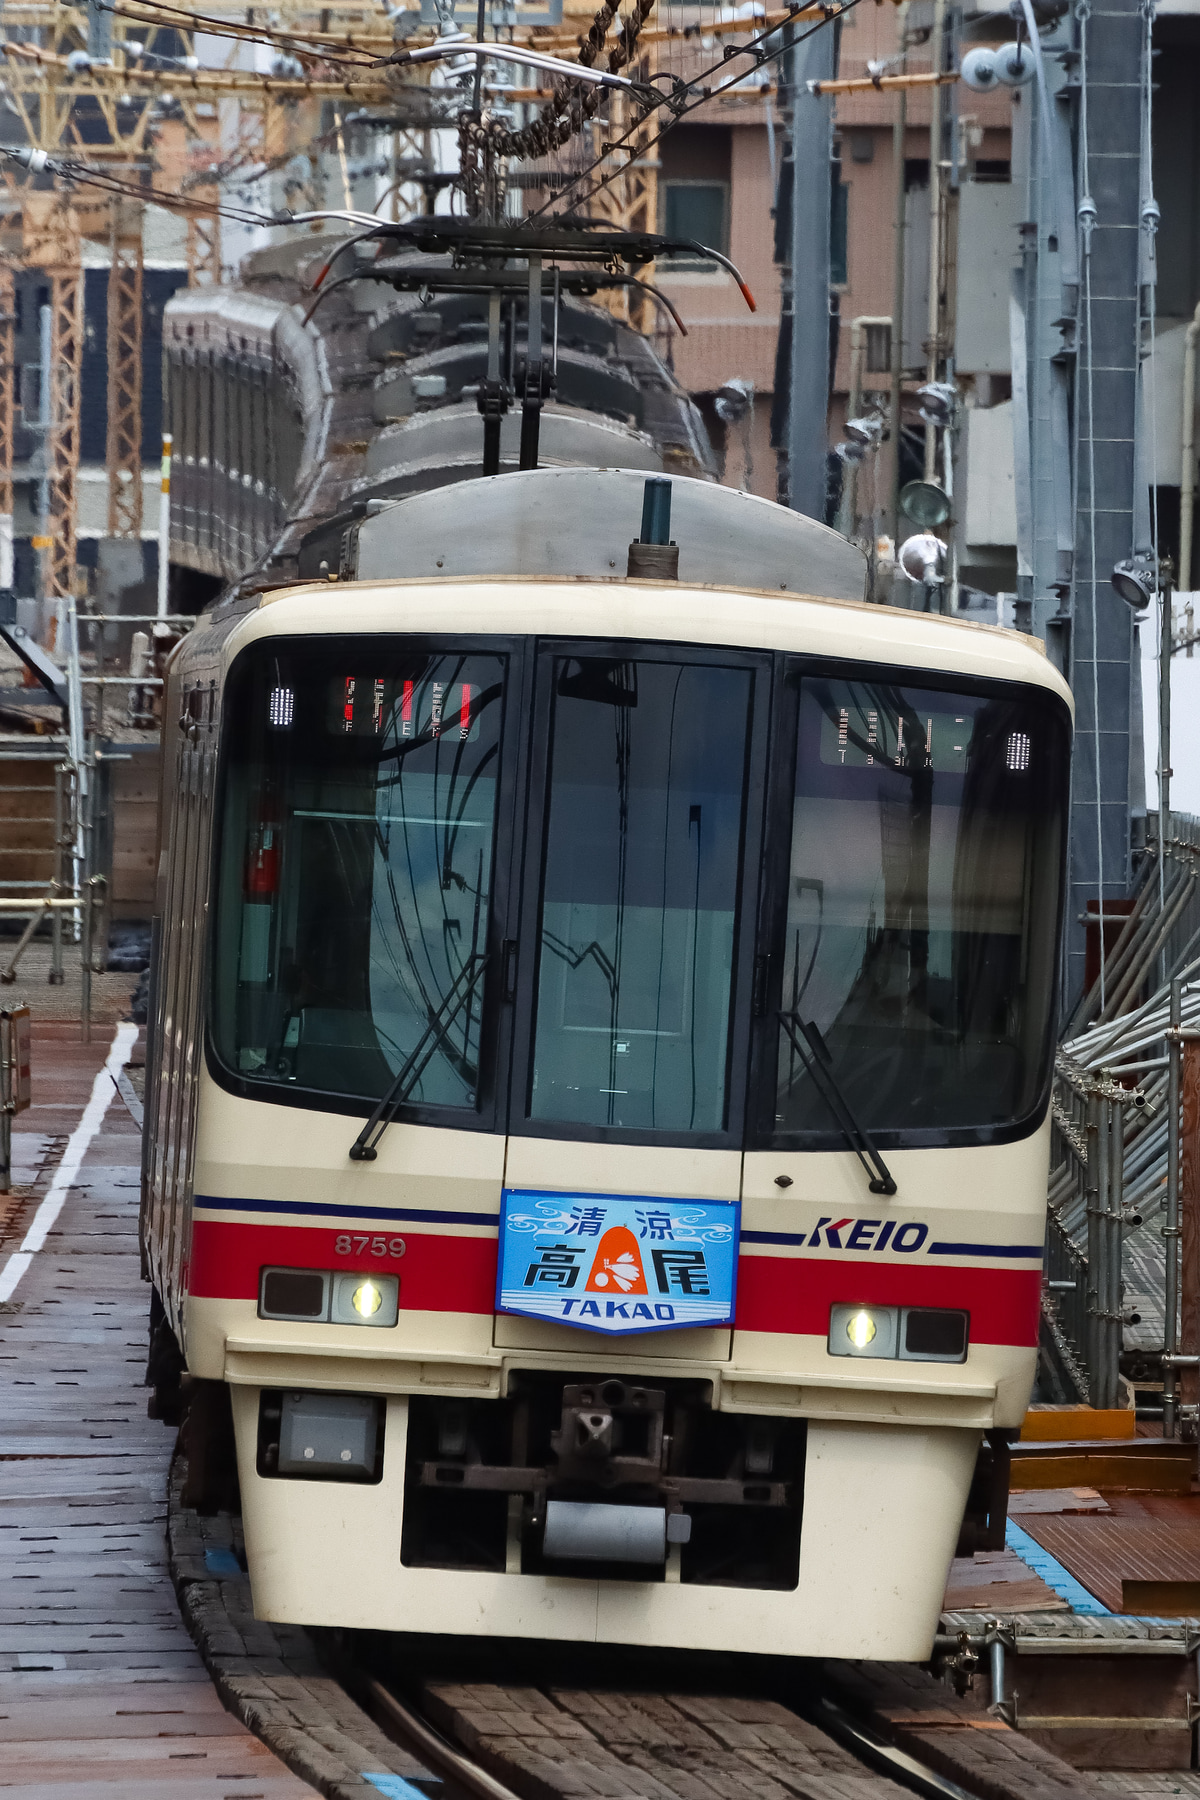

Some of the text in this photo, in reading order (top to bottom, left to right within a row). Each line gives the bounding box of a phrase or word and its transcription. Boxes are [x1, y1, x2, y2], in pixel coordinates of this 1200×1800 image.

[564, 1206, 675, 1241] 清涼
[807, 1217, 929, 1253] KEIO
[334, 1235, 407, 1258] 8759
[523, 1244, 711, 1296] 高尾
[560, 1298, 676, 1321] TAKAO
